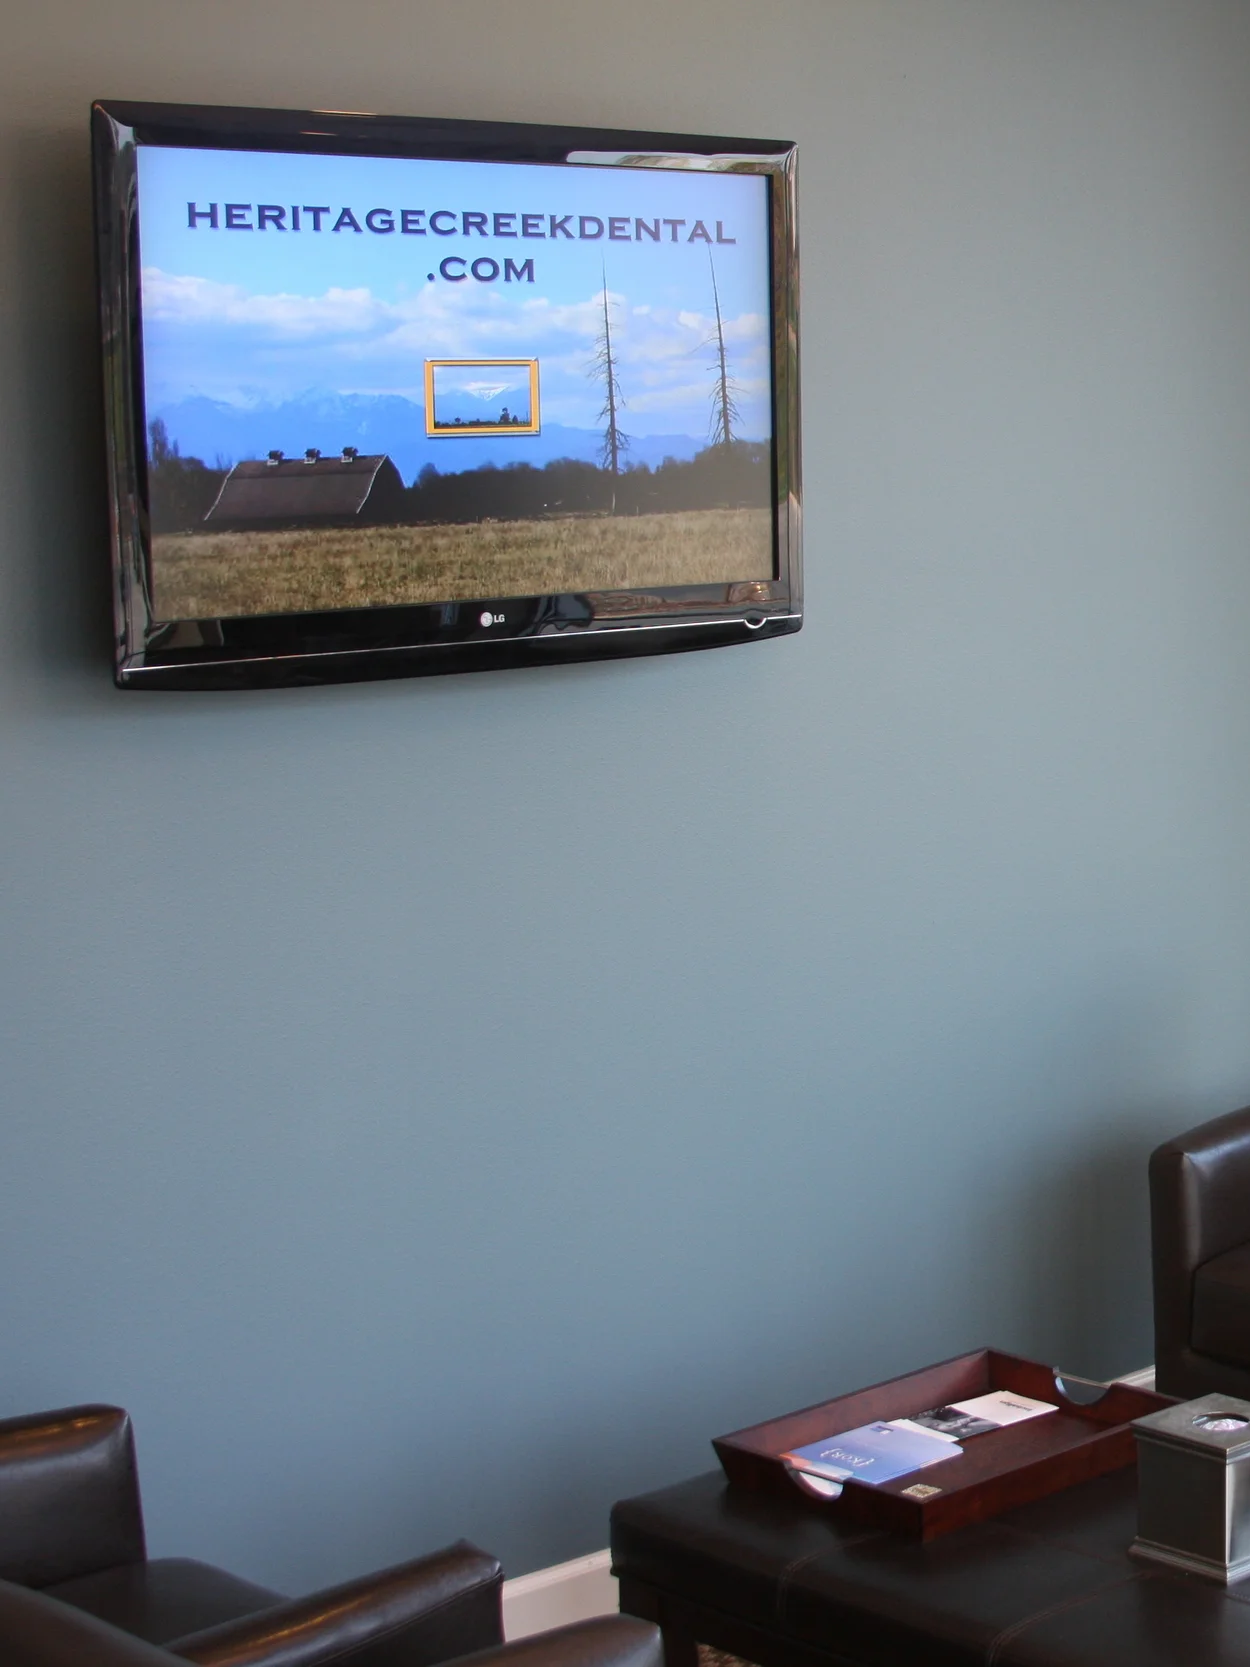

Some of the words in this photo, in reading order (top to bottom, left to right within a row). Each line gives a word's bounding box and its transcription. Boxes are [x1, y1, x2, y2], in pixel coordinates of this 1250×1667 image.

[187, 201, 737, 244] HERITAGECREEKDENTAL
[426, 256, 535, 282] .COM
[493, 613, 506, 623] LG
